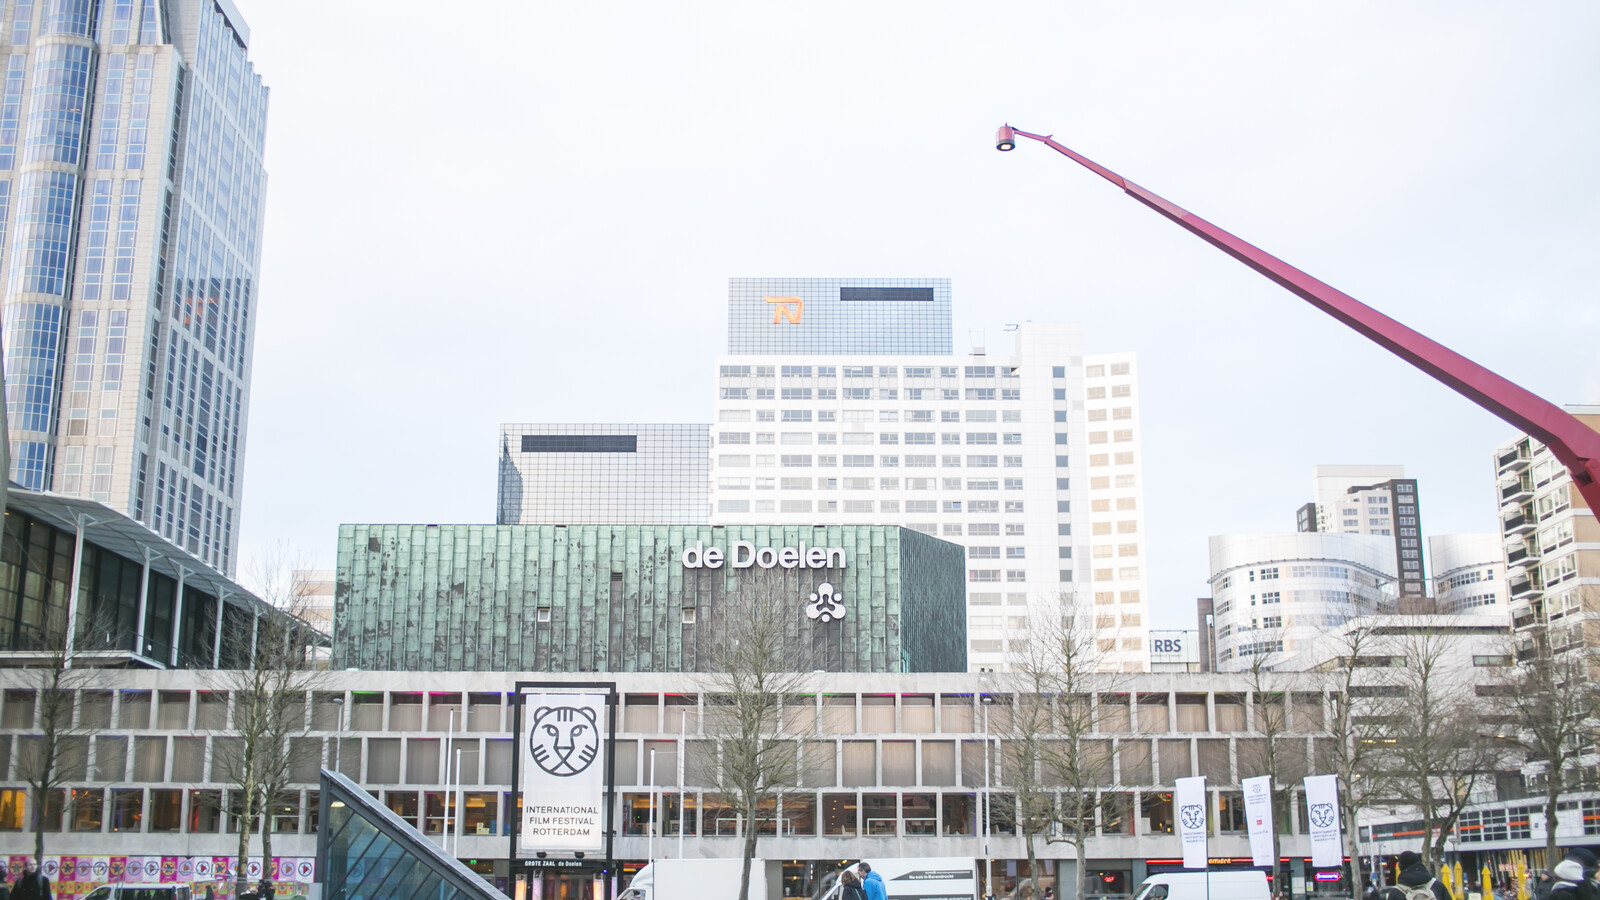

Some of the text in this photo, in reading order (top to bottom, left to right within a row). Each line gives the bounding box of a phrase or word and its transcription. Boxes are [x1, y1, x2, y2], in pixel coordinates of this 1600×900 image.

[682, 540, 846, 569] de Doelen
[1154, 639, 1182, 652] RBS
[526, 805, 599, 814] INTERNATIONAL
[529, 817, 594, 826] FILM FESTIVAL
[533, 828, 590, 836] ROTTERDAM
